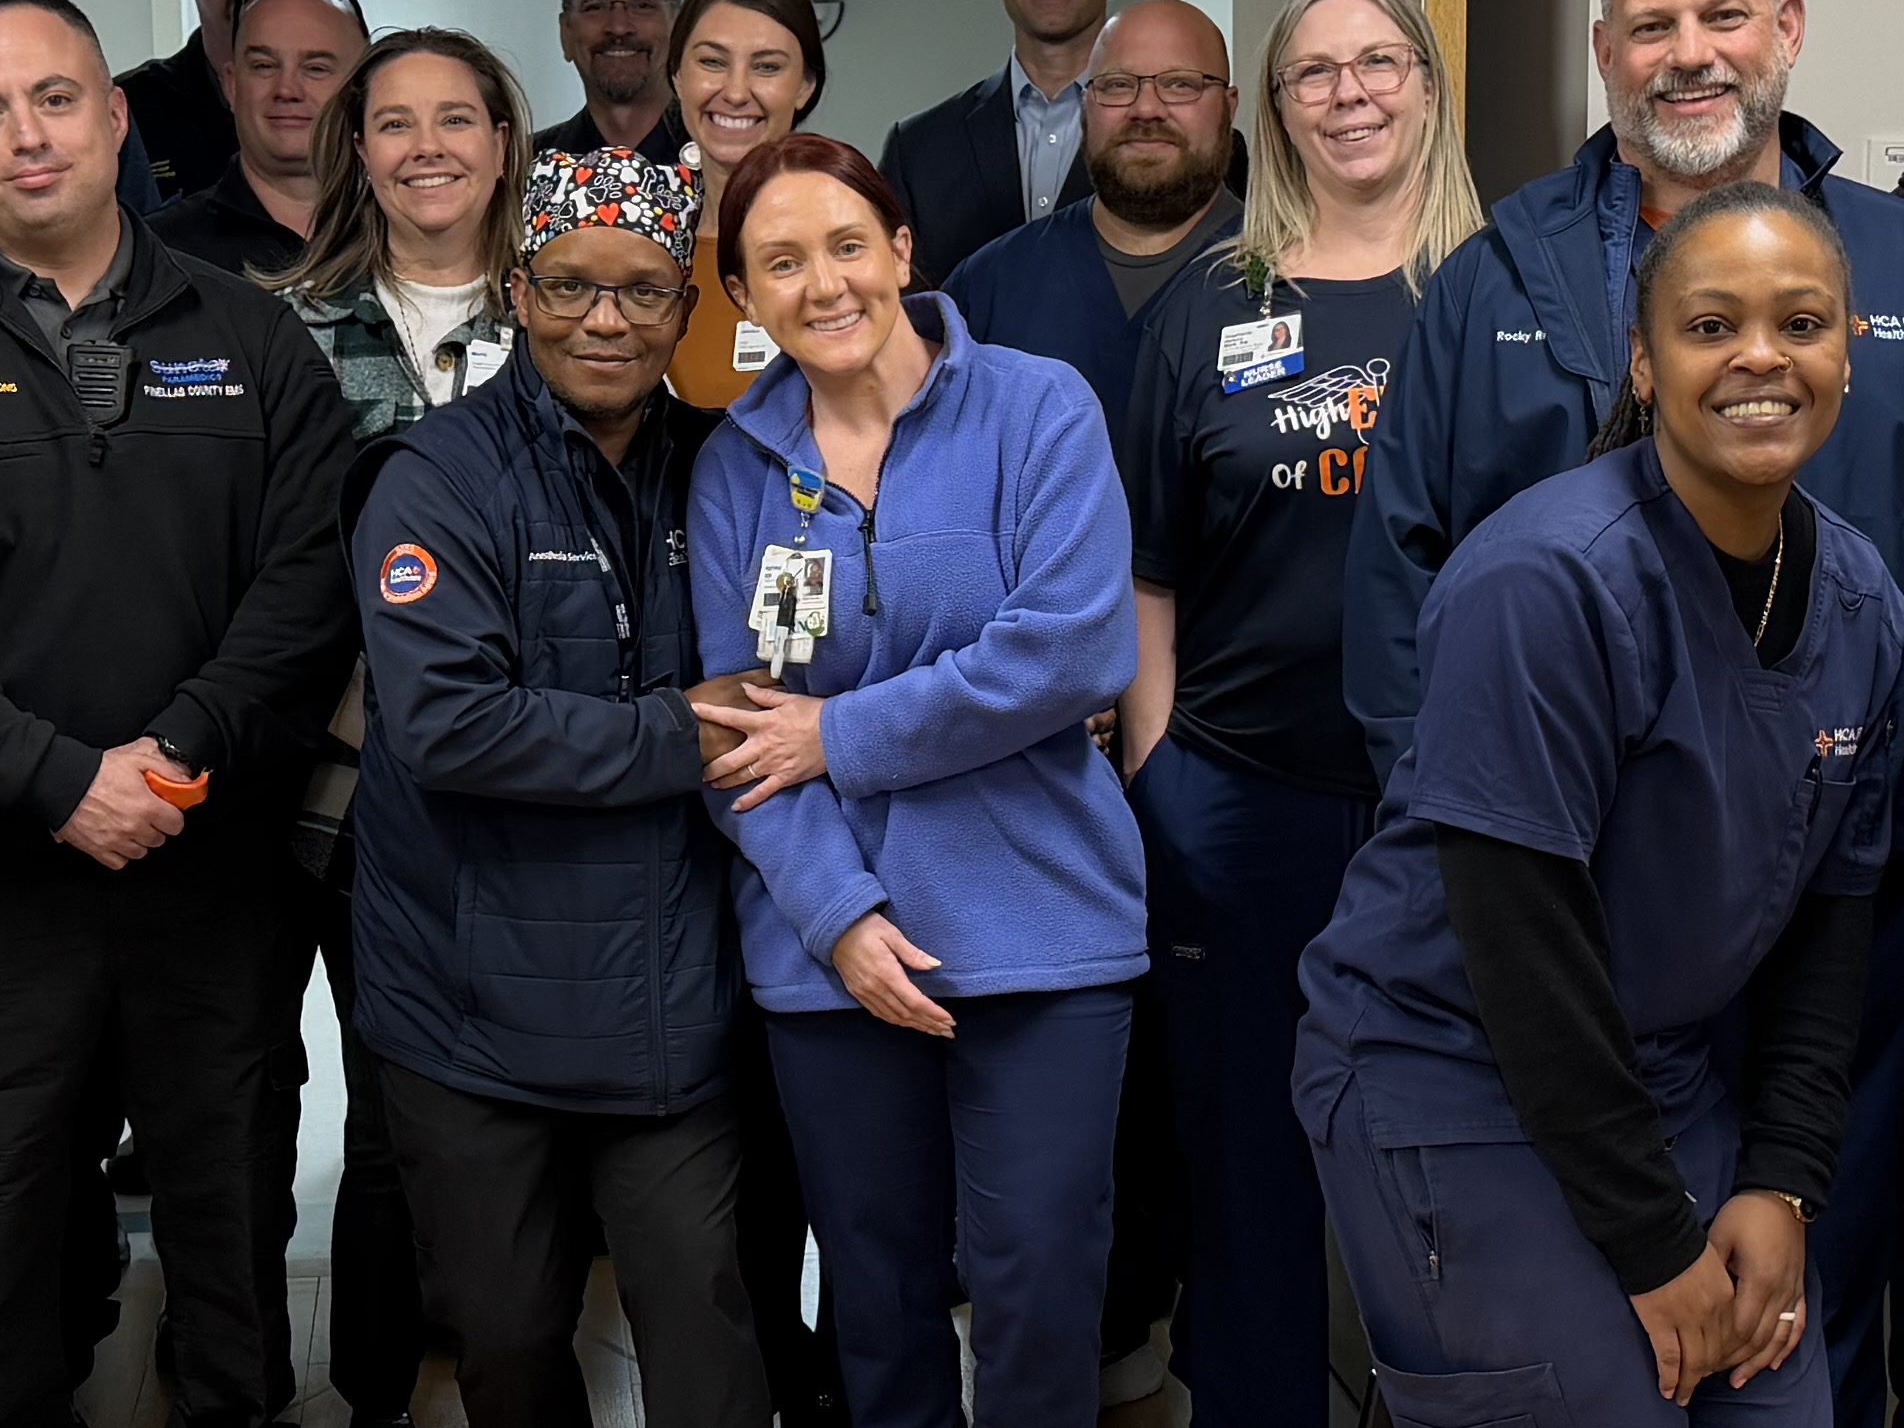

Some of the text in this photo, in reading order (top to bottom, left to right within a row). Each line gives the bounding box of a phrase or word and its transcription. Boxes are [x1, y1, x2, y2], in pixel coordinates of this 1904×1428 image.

[1869, 314, 1901, 328] HCA
[1496, 330, 1531, 343] Rocky
[1243, 360, 1282, 378] NURSE
[1240, 367, 1286, 388] LEADER
[187, 385, 223, 397] COUNTY
[225, 384, 245, 396] EMS
[1834, 727, 1855, 742] HCA
